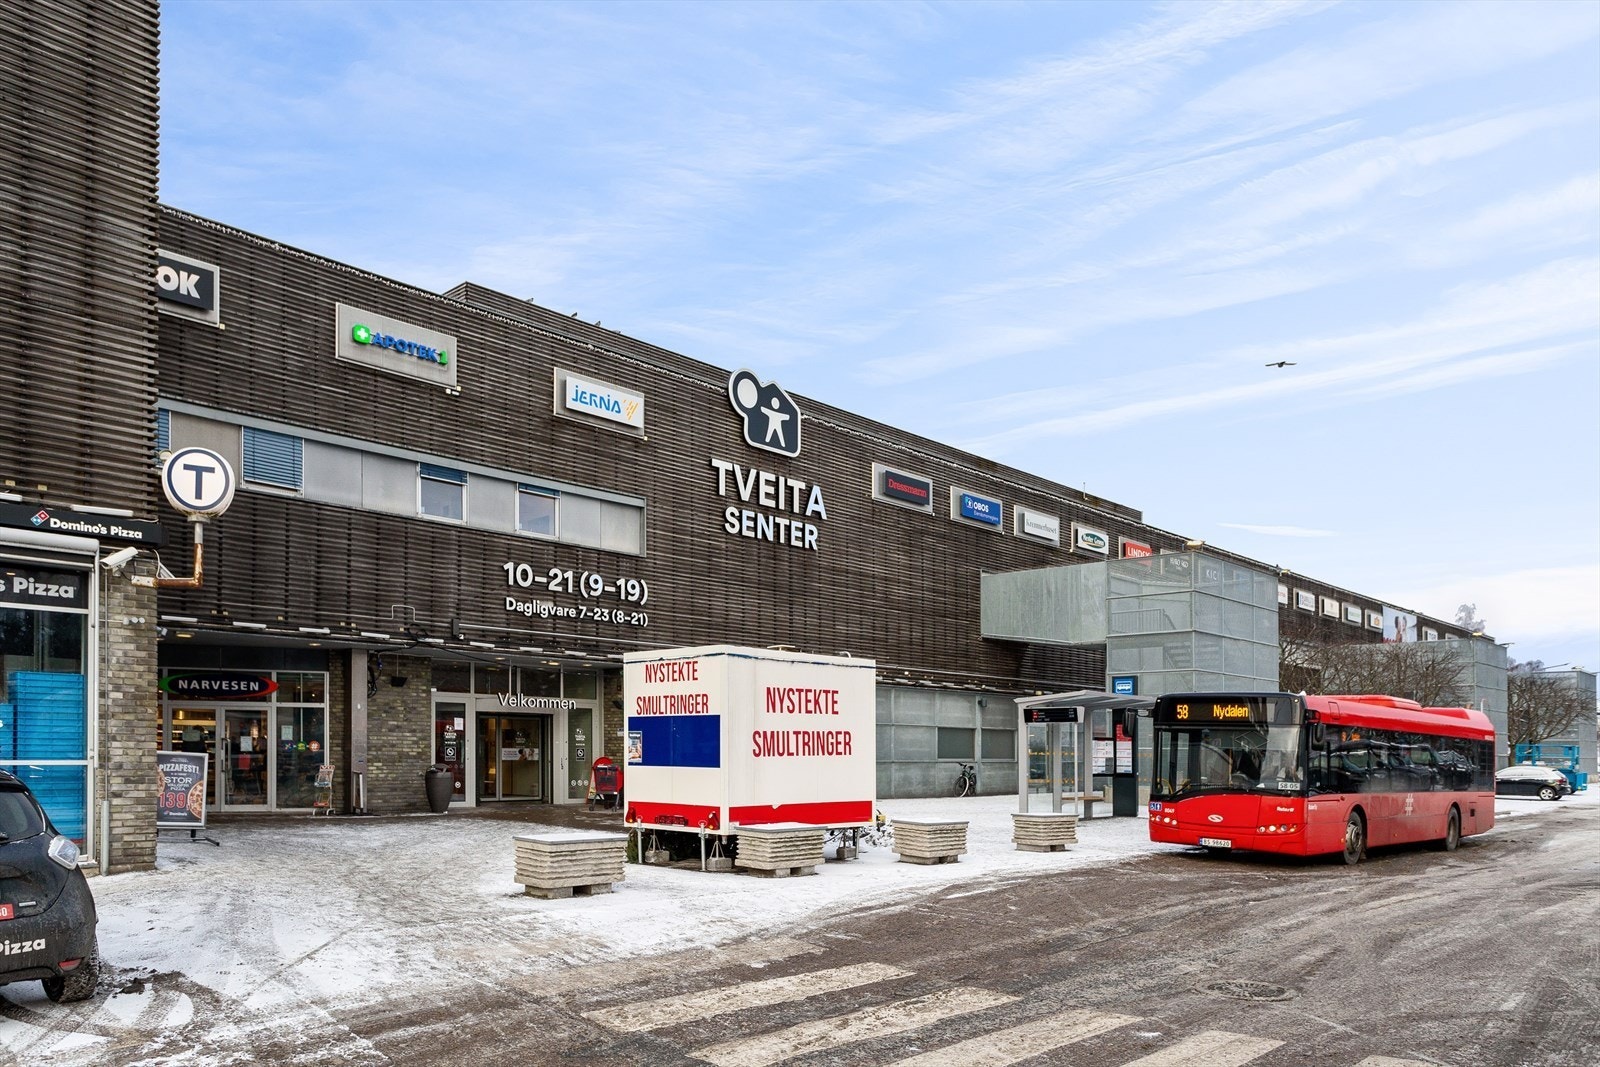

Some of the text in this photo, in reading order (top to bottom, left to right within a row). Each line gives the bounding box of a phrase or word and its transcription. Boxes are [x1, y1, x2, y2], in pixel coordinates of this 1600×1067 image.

[371, 332, 438, 363] APOTEK
[182, 463, 216, 500] T
[711, 458, 828, 520] TVEITA
[888, 478, 928, 498] Dressmann
[974, 501, 990, 513] OBOS
[50, 517, 143, 539] Domino's Pizza
[724, 506, 819, 551] SENTER
[13, 577, 74, 598] Pizza
[505, 597, 577, 618] Dagligvare
[645, 660, 699, 684] NYSTEKTE
[178, 679, 259, 691] NARVESEN
[498, 692, 577, 710] Velkommen
[636, 693, 709, 716] SMULTRINGER
[766, 686, 839, 715] NYSTEKTE
[1176, 704, 1249, 720] 58 Nydalen
[752, 730, 852, 758] SMULTRINGER
[165, 776, 193, 784] STOR
[0, 938, 46, 956] izza
